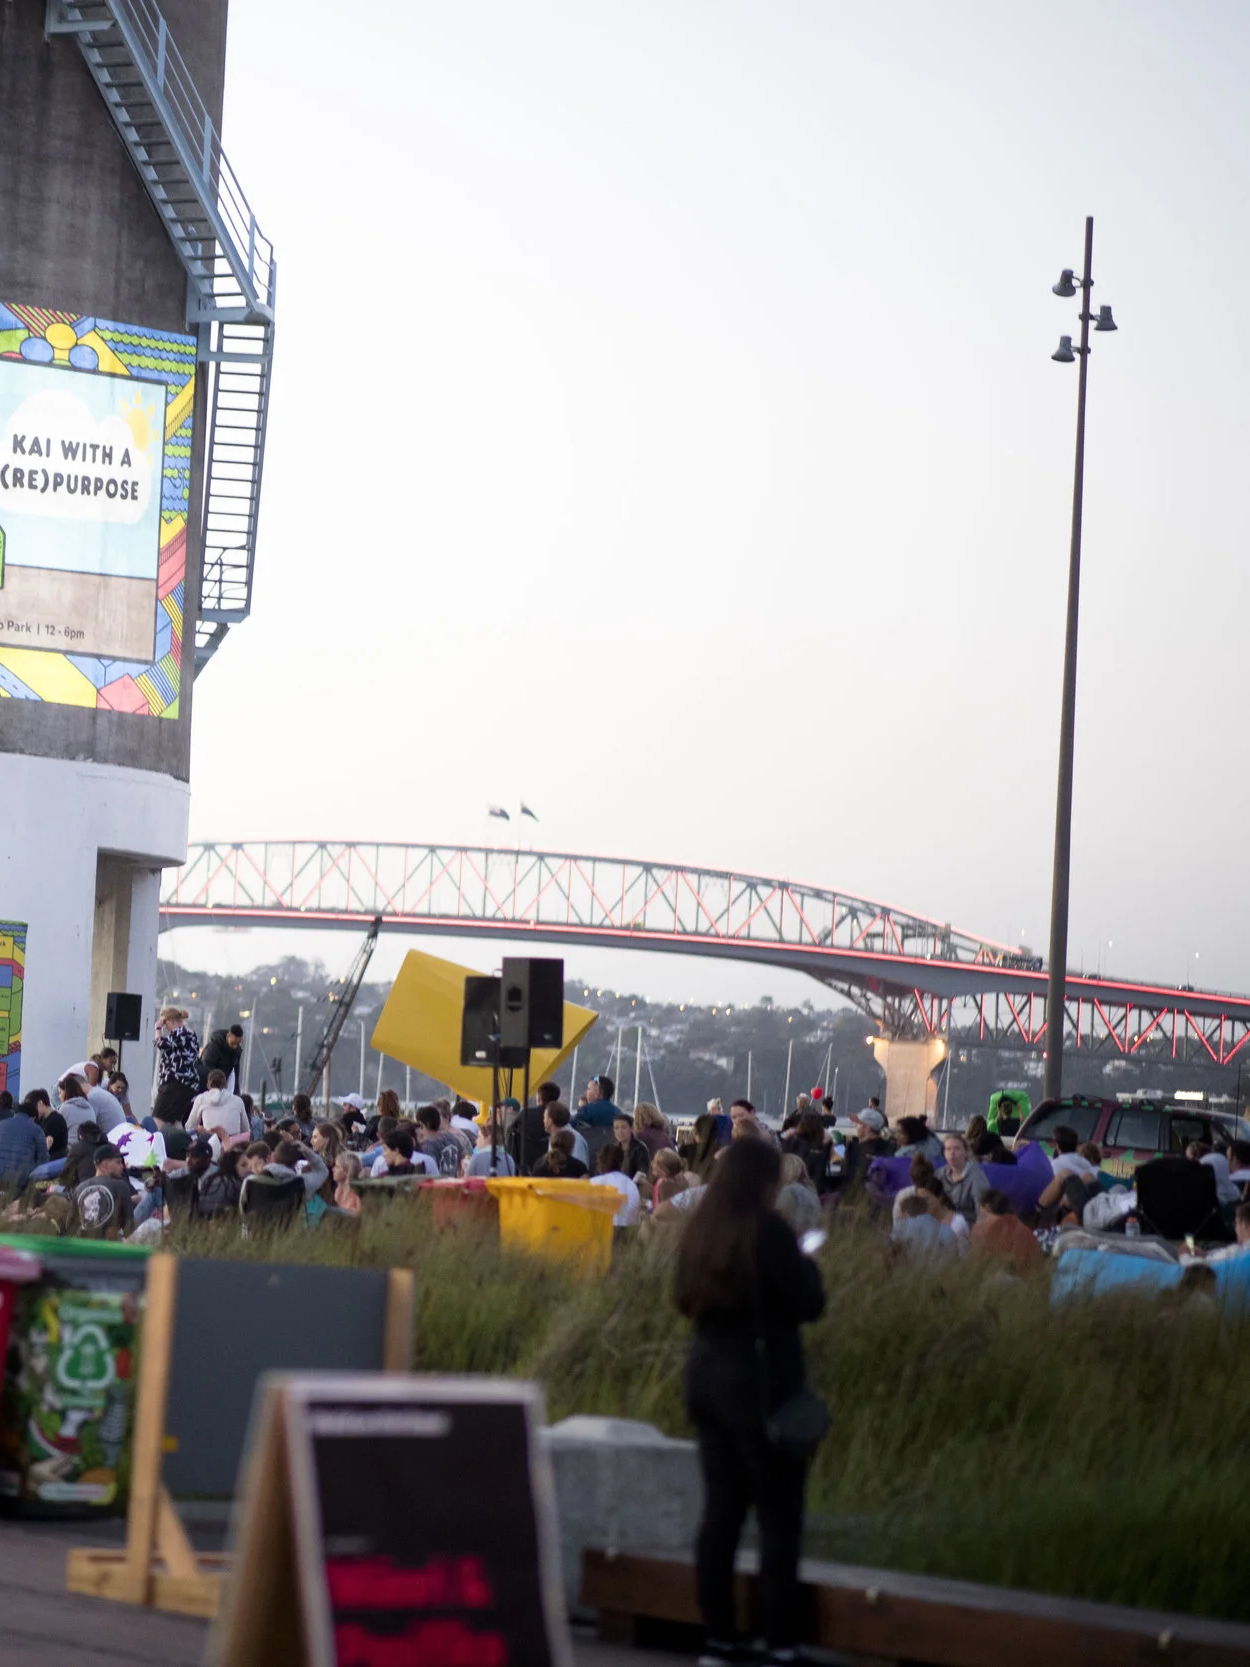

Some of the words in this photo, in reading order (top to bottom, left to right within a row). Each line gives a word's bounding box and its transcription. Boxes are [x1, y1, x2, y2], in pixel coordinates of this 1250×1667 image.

[12, 433, 51, 458] KAI
[60, 439, 114, 466] WITH
[120, 447, 133, 468] A
[0, 463, 140, 501] (RE)PURPOSE
[7, 618, 32, 634] Park
